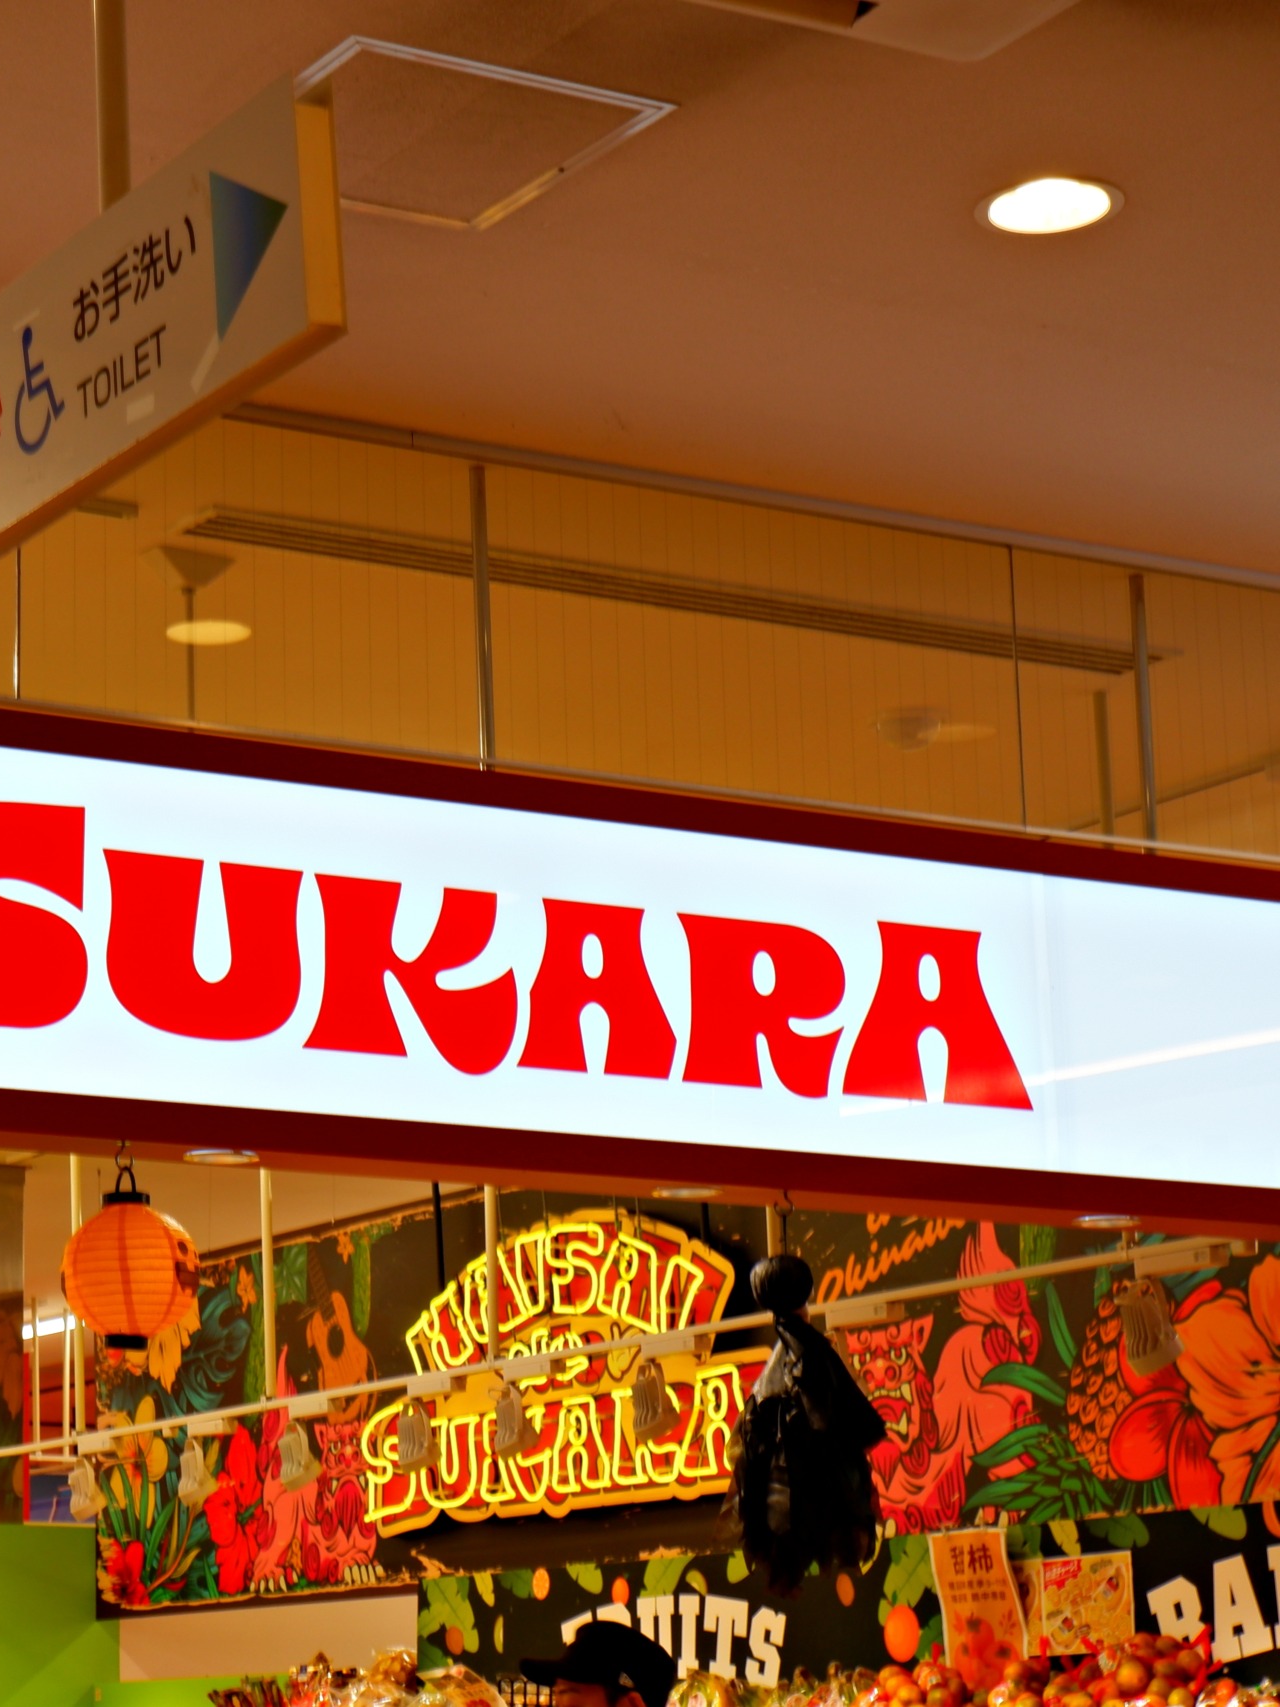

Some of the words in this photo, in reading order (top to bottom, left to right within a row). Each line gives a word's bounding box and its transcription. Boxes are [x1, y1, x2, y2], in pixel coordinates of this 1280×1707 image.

[72, 215, 197, 343] お手洗い
[76, 324, 168, 420] TOILET
[561, 1593, 787, 1689] UITS
